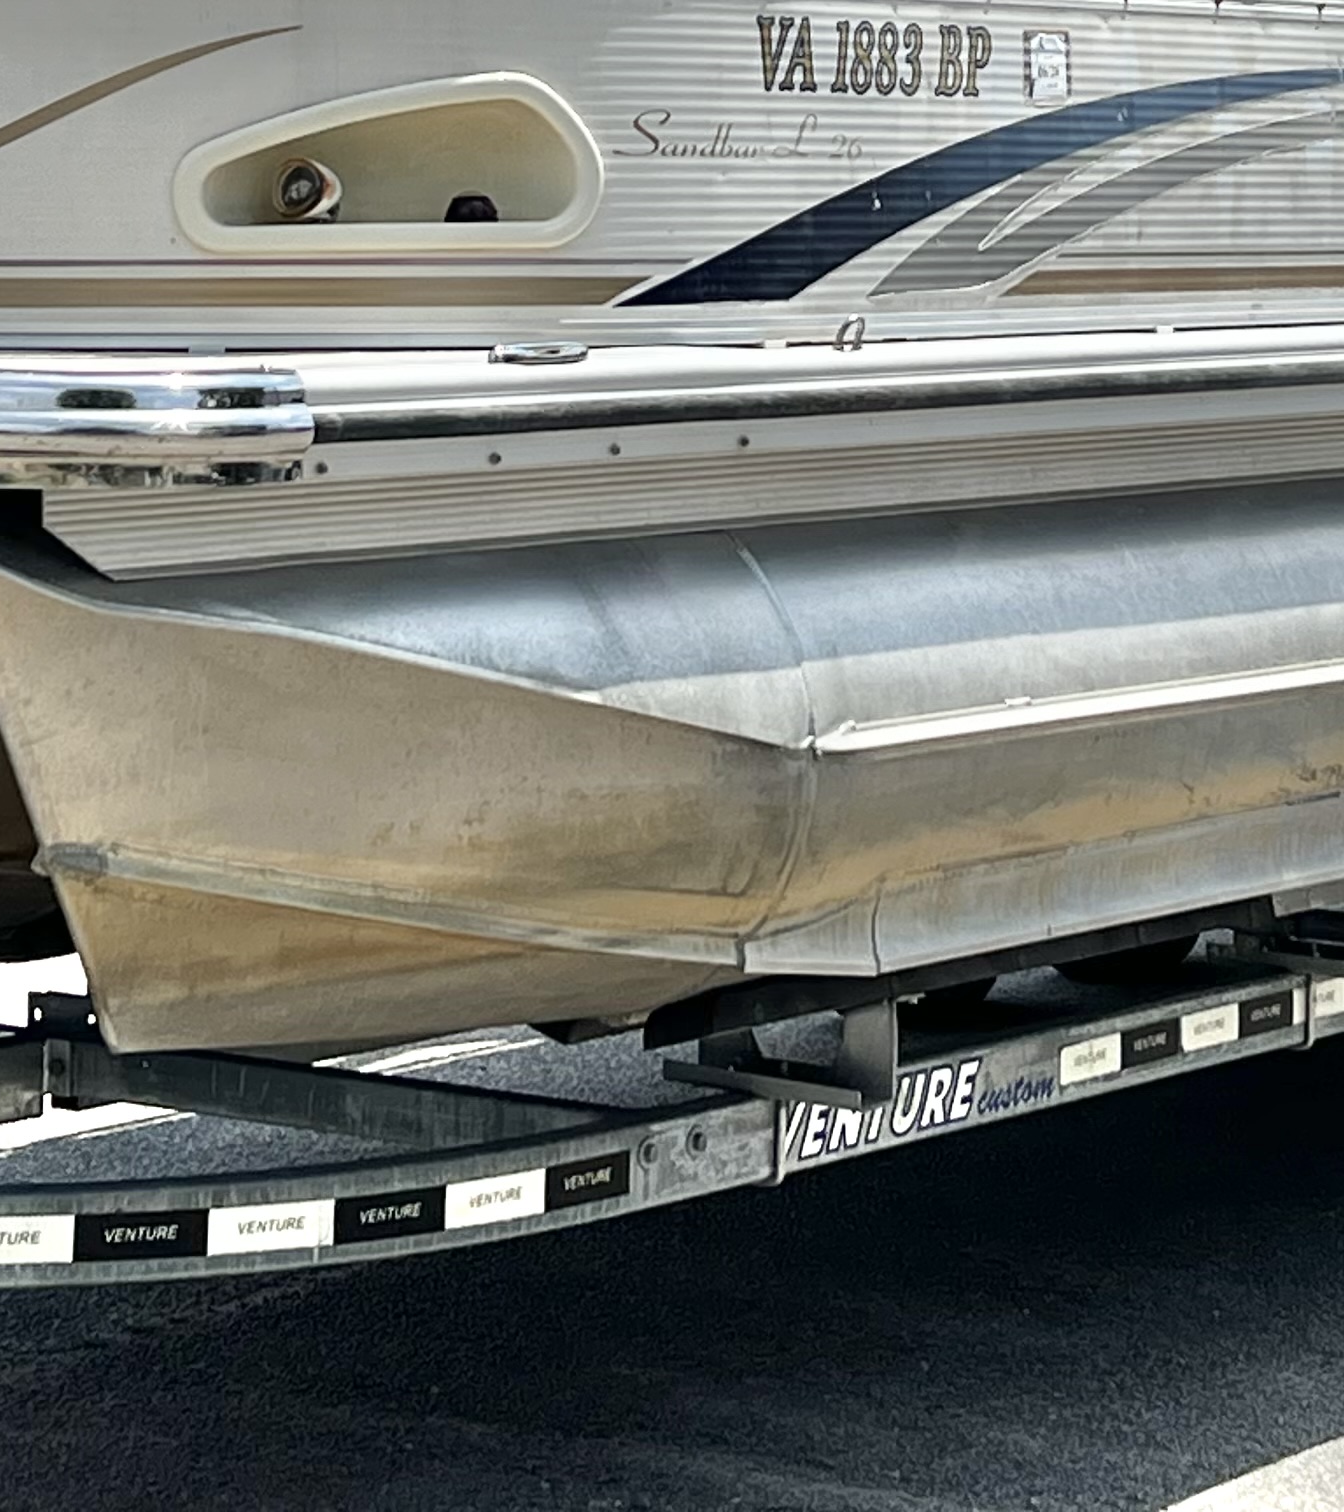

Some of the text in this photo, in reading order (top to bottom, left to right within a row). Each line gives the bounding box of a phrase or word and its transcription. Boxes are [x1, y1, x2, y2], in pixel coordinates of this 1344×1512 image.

[756, 15, 818, 93] VA
[830, 19, 923, 97] 1883
[934, 24, 993, 97] BP
[612, 108, 761, 159] Sandbar
[1133, 1032, 1167, 1052] VENTURE
[1250, 1003, 1282, 1022] VENTURE
[784, 1056, 1055, 1161] VENTURE custom
[103, 1224, 179, 1244] VENTURE
[237, 1215, 306, 1236] VENTURE
[359, 1201, 423, 1225] VENTURE
[468, 1185, 523, 1209] VENTURE
[563, 1166, 613, 1191] VENTURE
